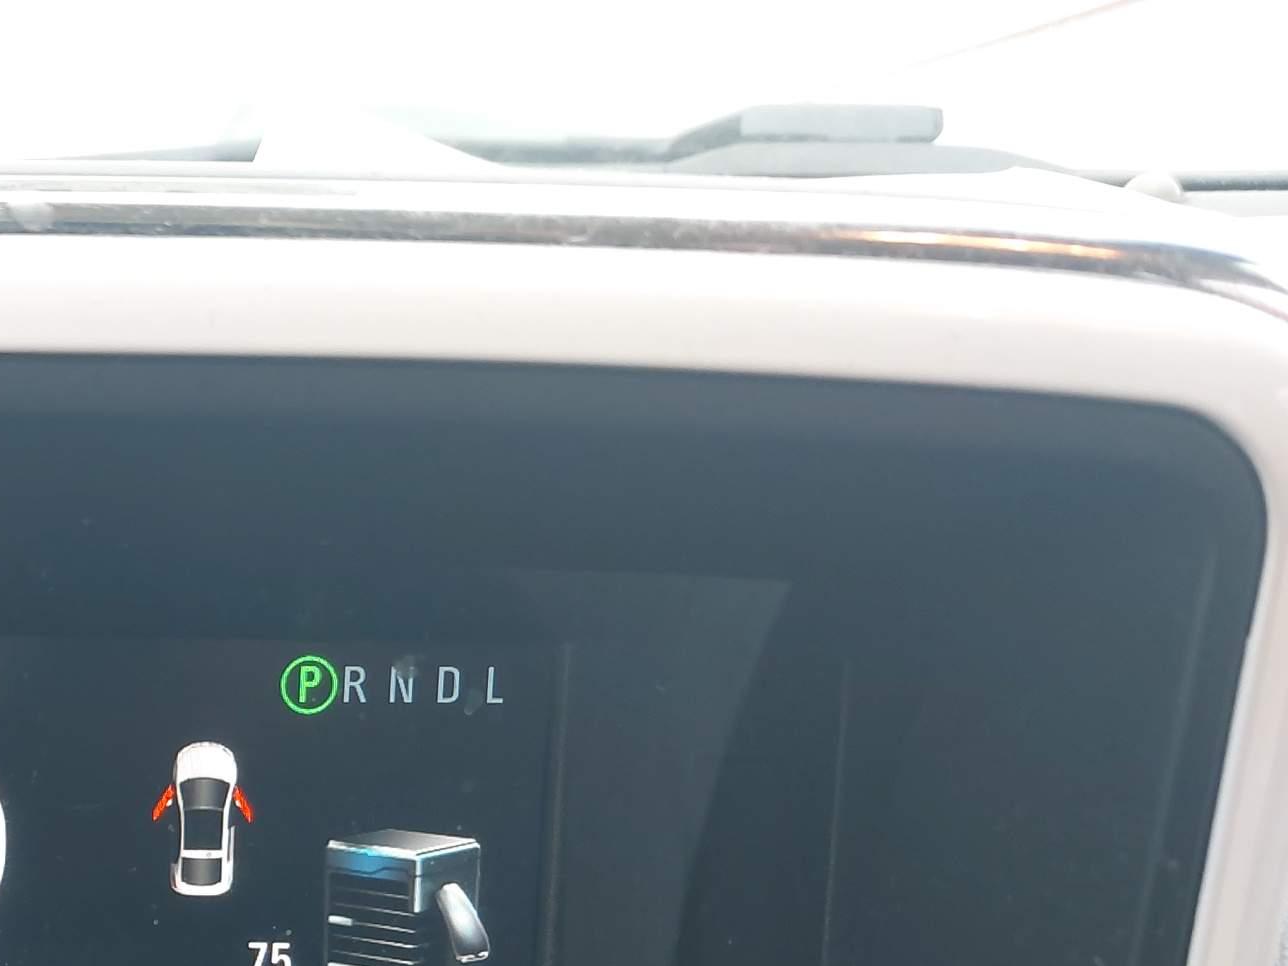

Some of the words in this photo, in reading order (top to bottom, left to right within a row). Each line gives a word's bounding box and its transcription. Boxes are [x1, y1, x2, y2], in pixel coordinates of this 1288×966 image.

[298, 666, 321, 703] P
[343, 667, 366, 702] R
[389, 667, 413, 702] N
[437, 667, 460, 703] D
[487, 667, 504, 704] L
